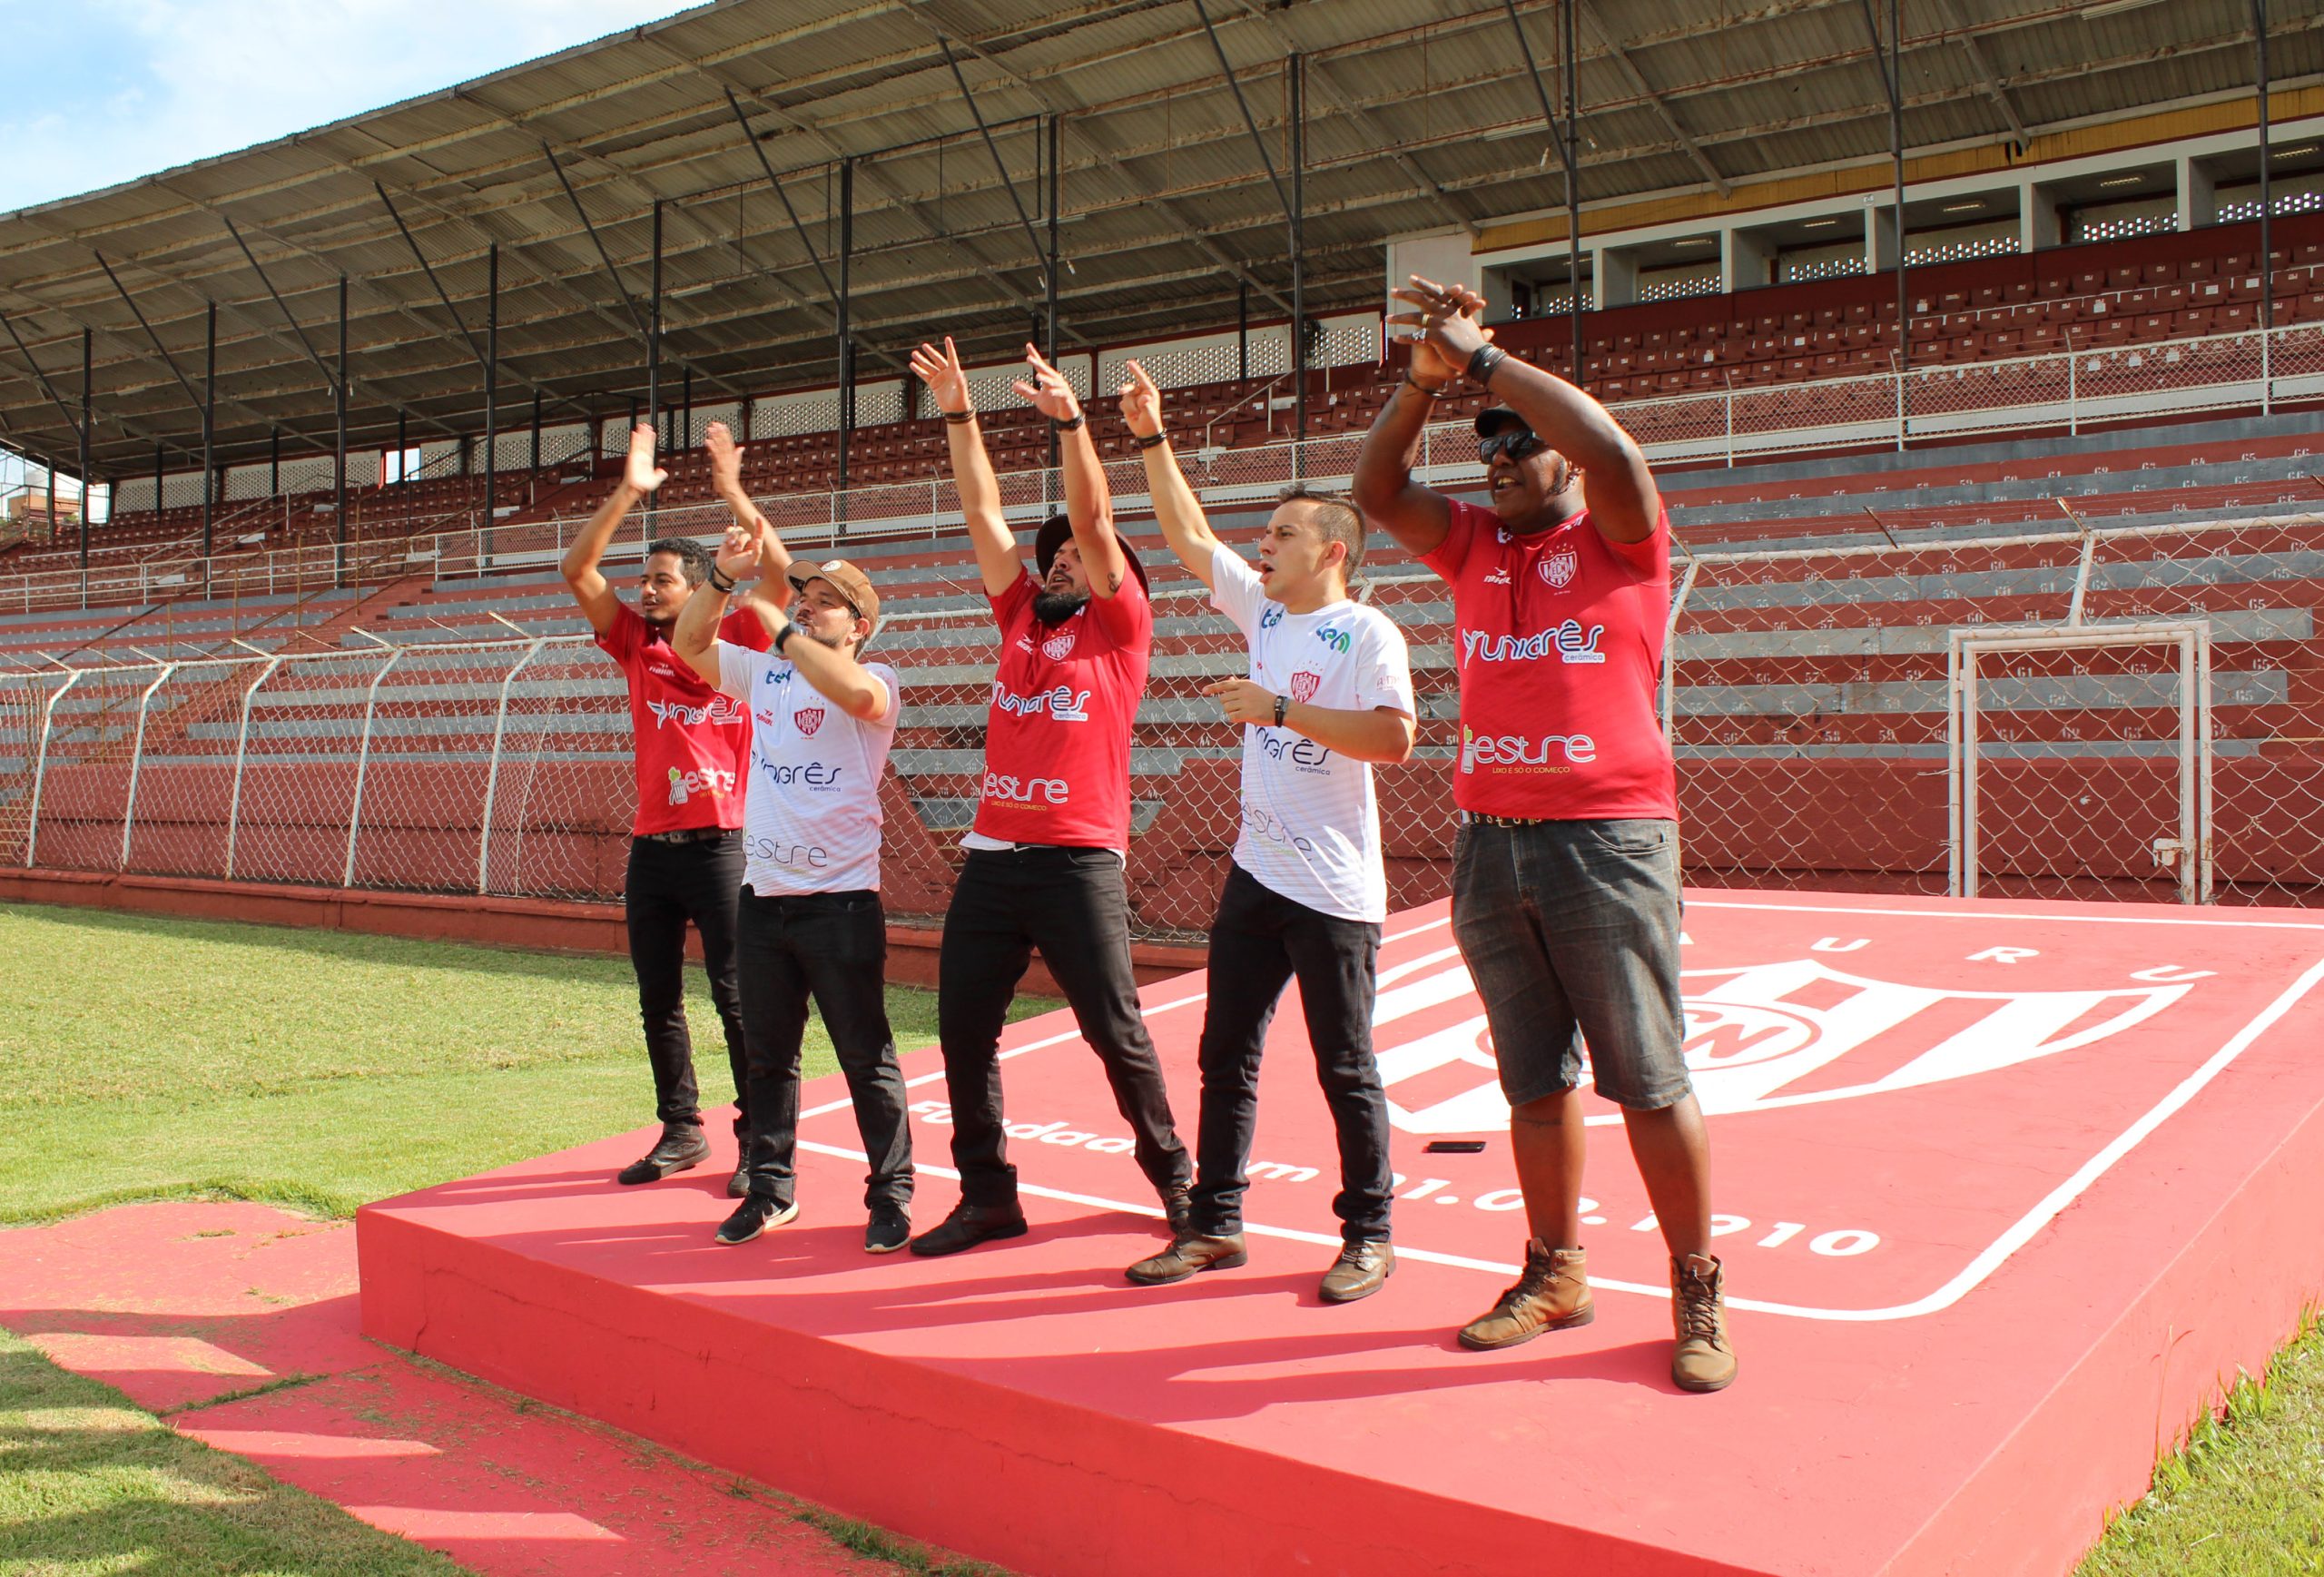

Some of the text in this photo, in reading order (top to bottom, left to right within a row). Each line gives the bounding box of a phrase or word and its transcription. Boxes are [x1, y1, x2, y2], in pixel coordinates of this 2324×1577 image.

[2241, 453, 2256, 462] 65
[1761, 575, 1773, 585] 55
[1942, 564, 1956, 574] 59
[1820, 619, 1833, 629] 57
[1868, 617, 1882, 627] 58
[1916, 616, 1932, 626] 59
[1967, 613, 1983, 623] 60
[2249, 598, 2265, 609] 65
[1564, 653, 1603, 661] cerâmica
[1906, 670, 1921, 681] 59
[2017, 666, 2033, 677] 61
[2235, 690, 2254, 701] 65
[1723, 733, 1738, 743] 56
[1825, 731, 1840, 742] 58
[1474, 734, 1596, 764] estre
[1295, 765, 1331, 775] cerâmica
[986, 773, 1068, 803] estre
[744, 835, 827, 868] estre
